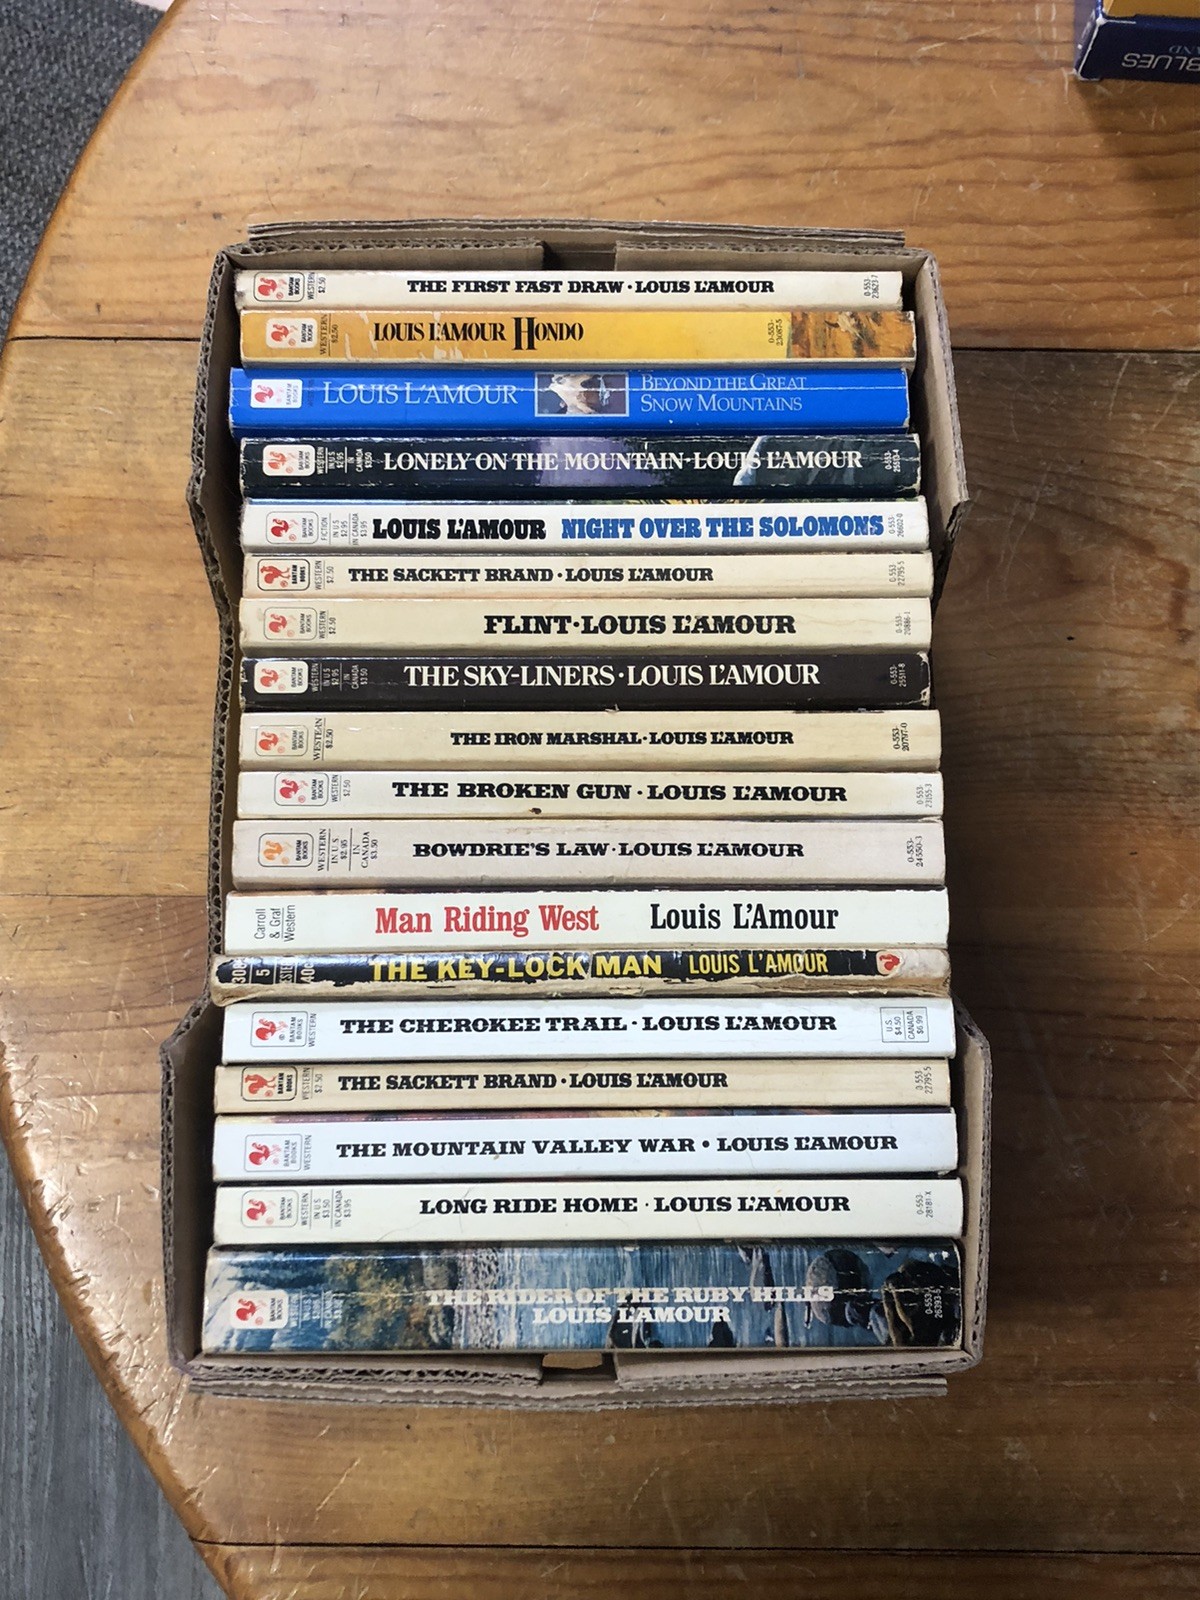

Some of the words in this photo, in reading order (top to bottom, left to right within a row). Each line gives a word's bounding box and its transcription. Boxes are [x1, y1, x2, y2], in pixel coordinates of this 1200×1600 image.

[1121, 53, 1200, 72] BLUES
[307, 272, 315, 300] WESTERN
[318, 277, 326, 293] $2.50
[407, 280, 447, 293] THE
[452, 280, 512, 293] FIRST
[515, 280, 563, 293] FAST
[568, 280, 624, 293] DRAW
[635, 280, 691, 293] LOUIS
[695, 280, 775, 294] L'AMOUR
[320, 314, 328, 355] WESTERN
[373, 322, 426, 341] LOUIS
[428, 322, 507, 342] L'AMOUR
[511, 316, 584, 351] HONDO
[641, 374, 712, 391] BEYOND
[714, 376, 746, 391] THE
[749, 372, 807, 391] GREAT
[322, 381, 399, 405] LOUIS
[404, 382, 518, 405] L'AMOUR
[640, 395, 693, 413] SNOW
[697, 394, 803, 412] MOUNTAINS
[384, 452, 472, 471] LONELY
[483, 452, 508, 471] ON
[512, 452, 558, 471] THE
[564, 452, 685, 471] MOUNTAIN
[697, 450, 761, 470] LOUIS
[766, 450, 863, 469] L'AMOUR
[372, 518, 441, 540] LOUIS
[447, 518, 547, 540] L'AMOUR
[561, 517, 635, 539] NIGHT
[639, 517, 703, 539] OVER
[705, 516, 755, 538] THE
[759, 515, 885, 537] SOLOMONS
[347, 568, 388, 583] THE
[393, 568, 481, 583] SACKETT
[485, 568, 554, 583] BRAND
[565, 567, 625, 582] LOUIS
[627, 567, 714, 582] L'AMOUR
[483, 615, 573, 635] FLINT
[581, 615, 667, 635] LOUIS
[672, 614, 797, 635] L'AMOUR
[311, 663, 319, 693] WESTERN
[403, 665, 459, 687] THE
[463, 664, 614, 687] SKY-LINERS
[627, 664, 703, 686] LOUIS
[708, 663, 820, 686] L'AMOUR
[313, 718, 323, 761] WESTERN
[325, 729, 334, 749] $2.50
[450, 732, 491, 746] THE
[494, 732, 543, 746] IRON
[546, 731, 642, 745] MARSHAL
[649, 731, 708, 745] LOUIS
[710, 731, 795, 745] L'AMOUR
[331, 774, 339, 802] WESTERN
[391, 782, 449, 798] THE
[457, 782, 571, 799] BROKEN
[576, 784, 631, 800] GUN
[647, 785, 727, 801] LOUIS
[732, 785, 848, 802] L'AMOUR
[318, 828, 327, 872] WESTERN
[353, 844, 360, 855] IN
[361, 831, 370, 869] CANADA
[371, 839, 379, 860] $3.50
[412, 842, 550, 858] BOWDRIE'S
[556, 842, 610, 857] LAW
[618, 842, 693, 857] LOUIS
[696, 843, 804, 858] L'AMOUR
[254, 908, 267, 940] Carroll
[269, 907, 281, 928] Graf
[284, 904, 296, 943] Western
[375, 907, 433, 934] Man
[443, 905, 531, 938] Riding
[538, 904, 599, 932] West
[650, 903, 721, 930] Louis
[732, 903, 839, 930] L'Amour
[269, 931, 280, 939] &
[256, 969, 271, 977] 5
[369, 960, 428, 981] THE
[438, 956, 588, 980] KEY-LOCK
[595, 954, 662, 977] MAN
[689, 954, 741, 976] LOUIS
[748, 952, 829, 974] L'AMOUR
[309, 1013, 317, 1048] WESTERN
[339, 1018, 394, 1034] THE
[400, 1017, 540, 1033] CHEROKEE
[545, 1016, 628, 1032] TRAIL
[642, 1016, 720, 1031] LOUIS
[724, 1015, 837, 1031] L'AMOUR
[894, 1016, 902, 1036] $4.50
[907, 1010, 915, 1040] CANADA
[916, 1015, 924, 1035] $6.99
[302, 1067, 311, 1100] WESTERN
[338, 1075, 381, 1091] THE
[386, 1075, 479, 1090] SACKETT
[482, 1074, 557, 1089] BRAND
[569, 1073, 632, 1089] LOUIS
[636, 1072, 728, 1088] L'AMOUR
[304, 1134, 312, 1171] WESTERN
[336, 1143, 387, 1159] THE
[392, 1141, 527, 1158] MOUNTAIN
[531, 1139, 633, 1156] VALLEY
[638, 1138, 696, 1154] WAR
[716, 1136, 789, 1152] LOUIS
[794, 1135, 899, 1151] L'AMOUR
[301, 1192, 309, 1226] WESTERN
[419, 1199, 488, 1215] LONG
[493, 1198, 557, 1214] RIDE
[562, 1197, 638, 1213] HOME
[653, 1196, 733, 1212] LOUIS
[737, 1195, 851, 1212] L'AMOUR
[427, 1289, 482, 1306] THE
[486, 1288, 573, 1305] RIDER
[575, 1287, 610, 1304] OF
[611, 1286, 669, 1304] THE
[673, 1286, 749, 1303] RUBY
[752, 1285, 835, 1302] HILLS
[532, 1307, 612, 1324] LOUIS
[617, 1306, 731, 1323] L'AMOUR
